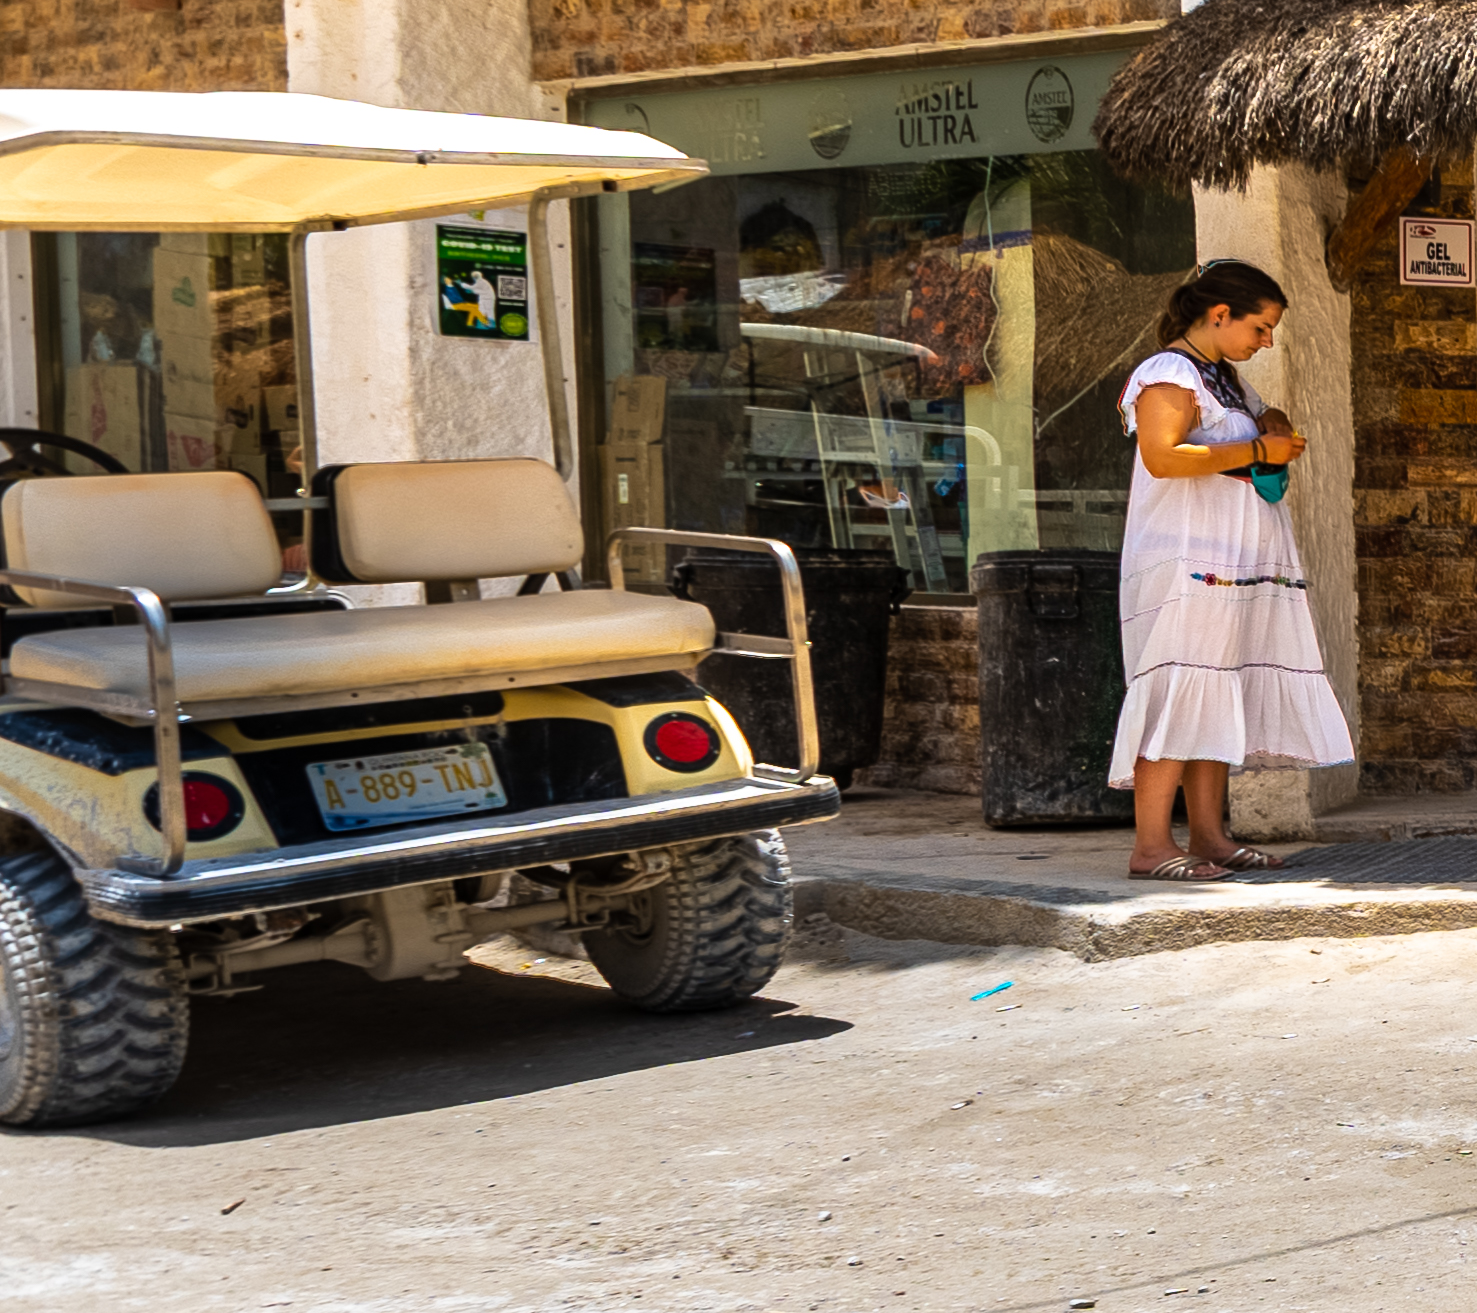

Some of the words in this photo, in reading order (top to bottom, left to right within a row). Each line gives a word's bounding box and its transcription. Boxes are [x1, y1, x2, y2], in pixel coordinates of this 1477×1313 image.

[895, 78, 978, 116] AMSTEL
[1032, 90, 1068, 106] AMSTEL
[899, 113, 976, 148] ULTRA
[1426, 242, 1451, 261] GEL
[1410, 260, 1467, 277] ANTIBACTERIAL
[325, 758, 493, 810] A-889-TNJ
